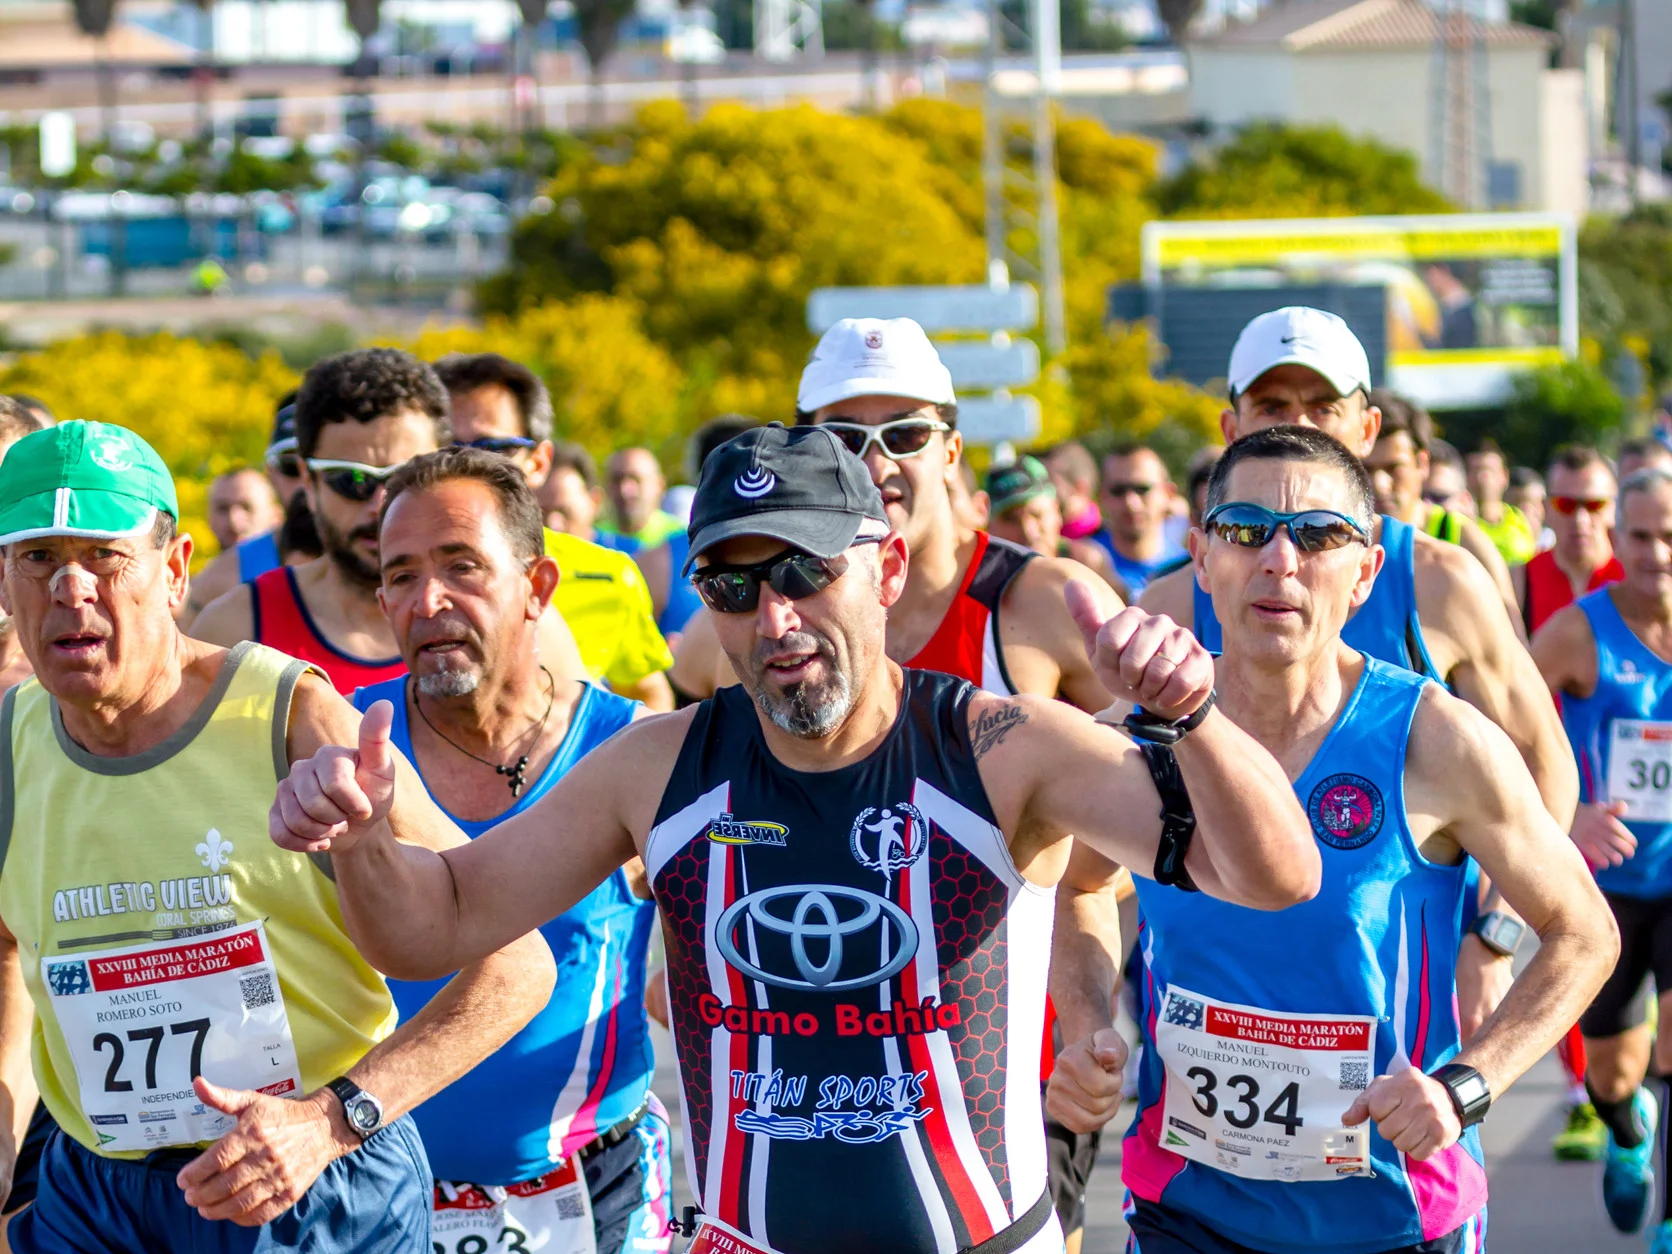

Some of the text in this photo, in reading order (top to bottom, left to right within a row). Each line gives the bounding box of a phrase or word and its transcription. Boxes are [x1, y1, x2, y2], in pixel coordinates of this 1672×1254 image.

[53, 873, 232, 922] ATHLETIC VIEW
[155, 905, 236, 928] CORAL SPRINGS
[177, 926, 207, 938] SINCE
[96, 936, 254, 975] XXVIII MEDIA MARATÓN
[123, 962, 166, 984] BAHÍA
[168, 964, 185, 976] DE
[187, 955, 231, 974] CÁDIZ
[109, 989, 162, 1006] MANUEL
[96, 1001, 182, 1023] ROMERO SOTO
[699, 993, 961, 1038] Gamo Bahía
[1214, 1010, 1364, 1035] XXVIII MEDIA MARATÓN
[1237, 1026, 1338, 1047] BAHÍA DE CÁDIZ
[93, 1017, 211, 1092] 277
[1177, 1042, 1311, 1077] IZQUIERDO MONTOUTO
[1217, 1040, 1269, 1057] MANUEL
[271, 1057, 279, 1066] L
[142, 1090, 197, 1105] INDEPENDIE
[731, 1068, 929, 1109] TITÁN SPORTS
[1186, 1066, 1304, 1136] 334
[1222, 1129, 1265, 1144] CARMONA
[1267, 1137, 1290, 1148] PAEZ
[1345, 1135, 1354, 1143] M
